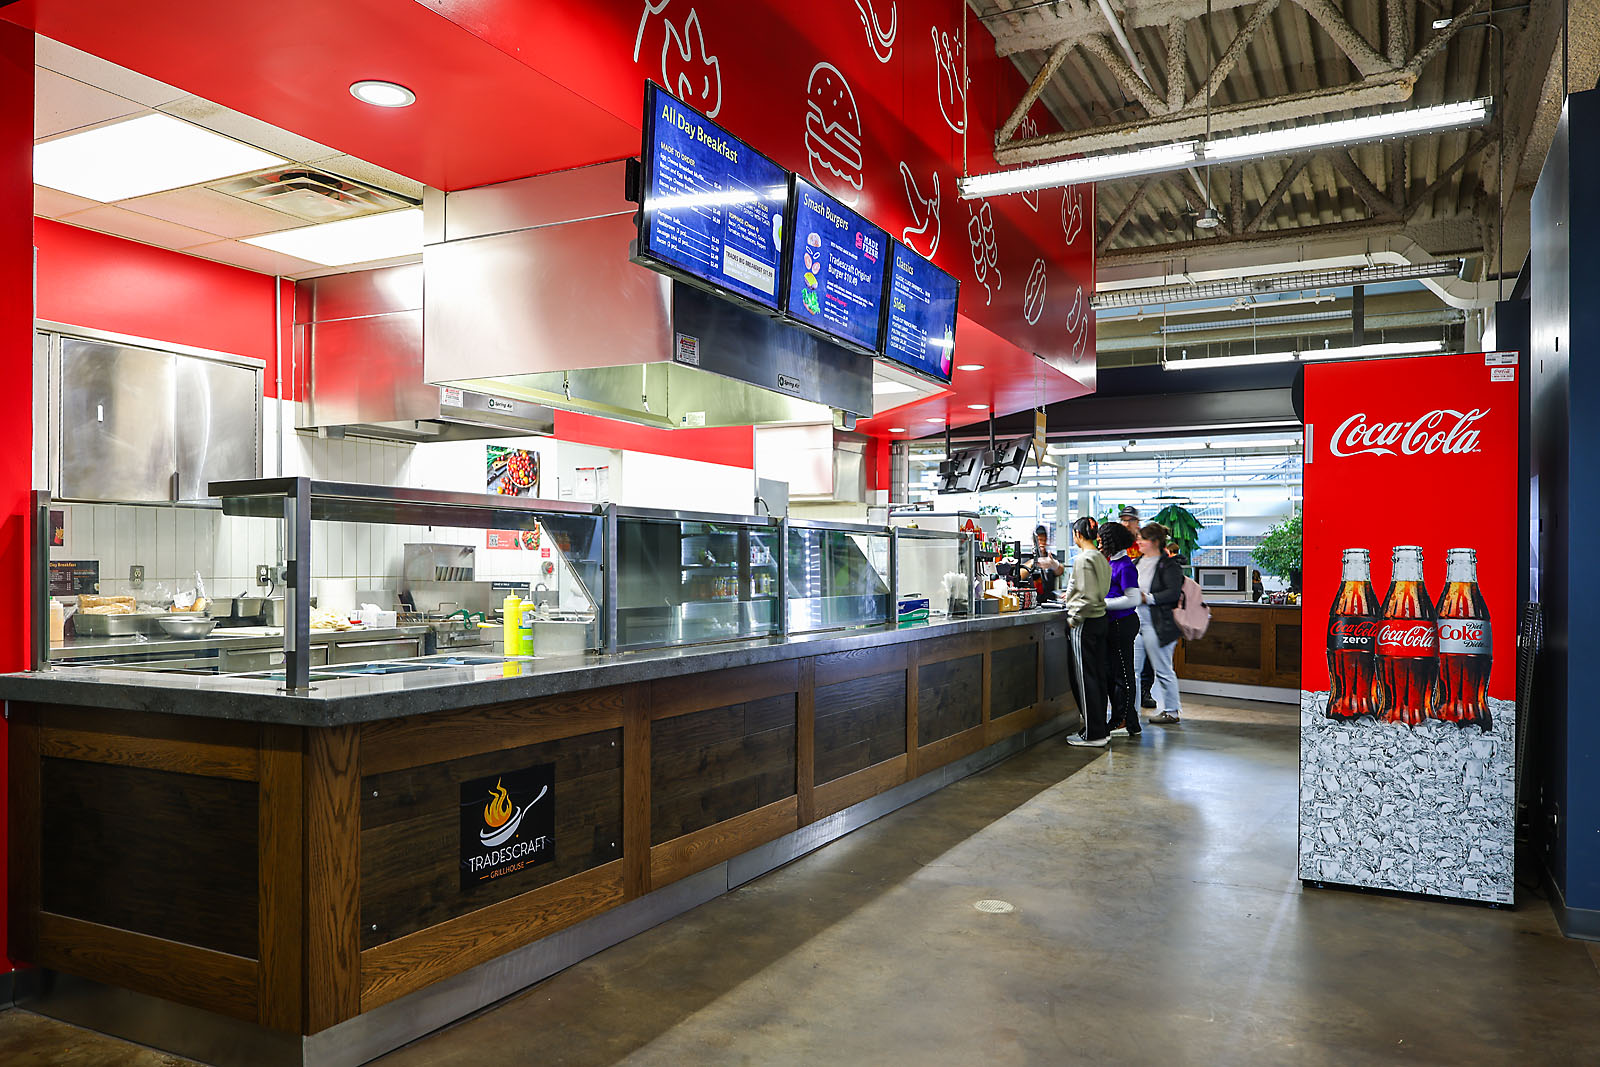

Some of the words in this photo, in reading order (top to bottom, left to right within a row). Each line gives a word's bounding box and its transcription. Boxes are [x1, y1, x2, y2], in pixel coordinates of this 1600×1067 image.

[662, 104, 676, 125] All
[678, 113, 695, 139] Day
[697, 125, 738, 164] Breakfast
[804, 193, 825, 217] Smash
[826, 206, 848, 230] Burgers
[864, 235, 878, 250] MADE
[828, 264, 843, 279] Burger
[830, 253, 855, 274] Tradescraft
[855, 268, 871, 283] Original
[896, 256, 914, 275] Classics
[893, 297, 906, 312] Sides
[1330, 408, 1491, 457] Coca-Cola
[1330, 620, 1377, 637] Coca-Cola
[1377, 625, 1436, 648] Coca-Cola
[1439, 625, 1483, 640] Coke
[469, 835, 546, 872] TRADESCRAFT
[490, 861, 524, 879] GRILLHOUSE
